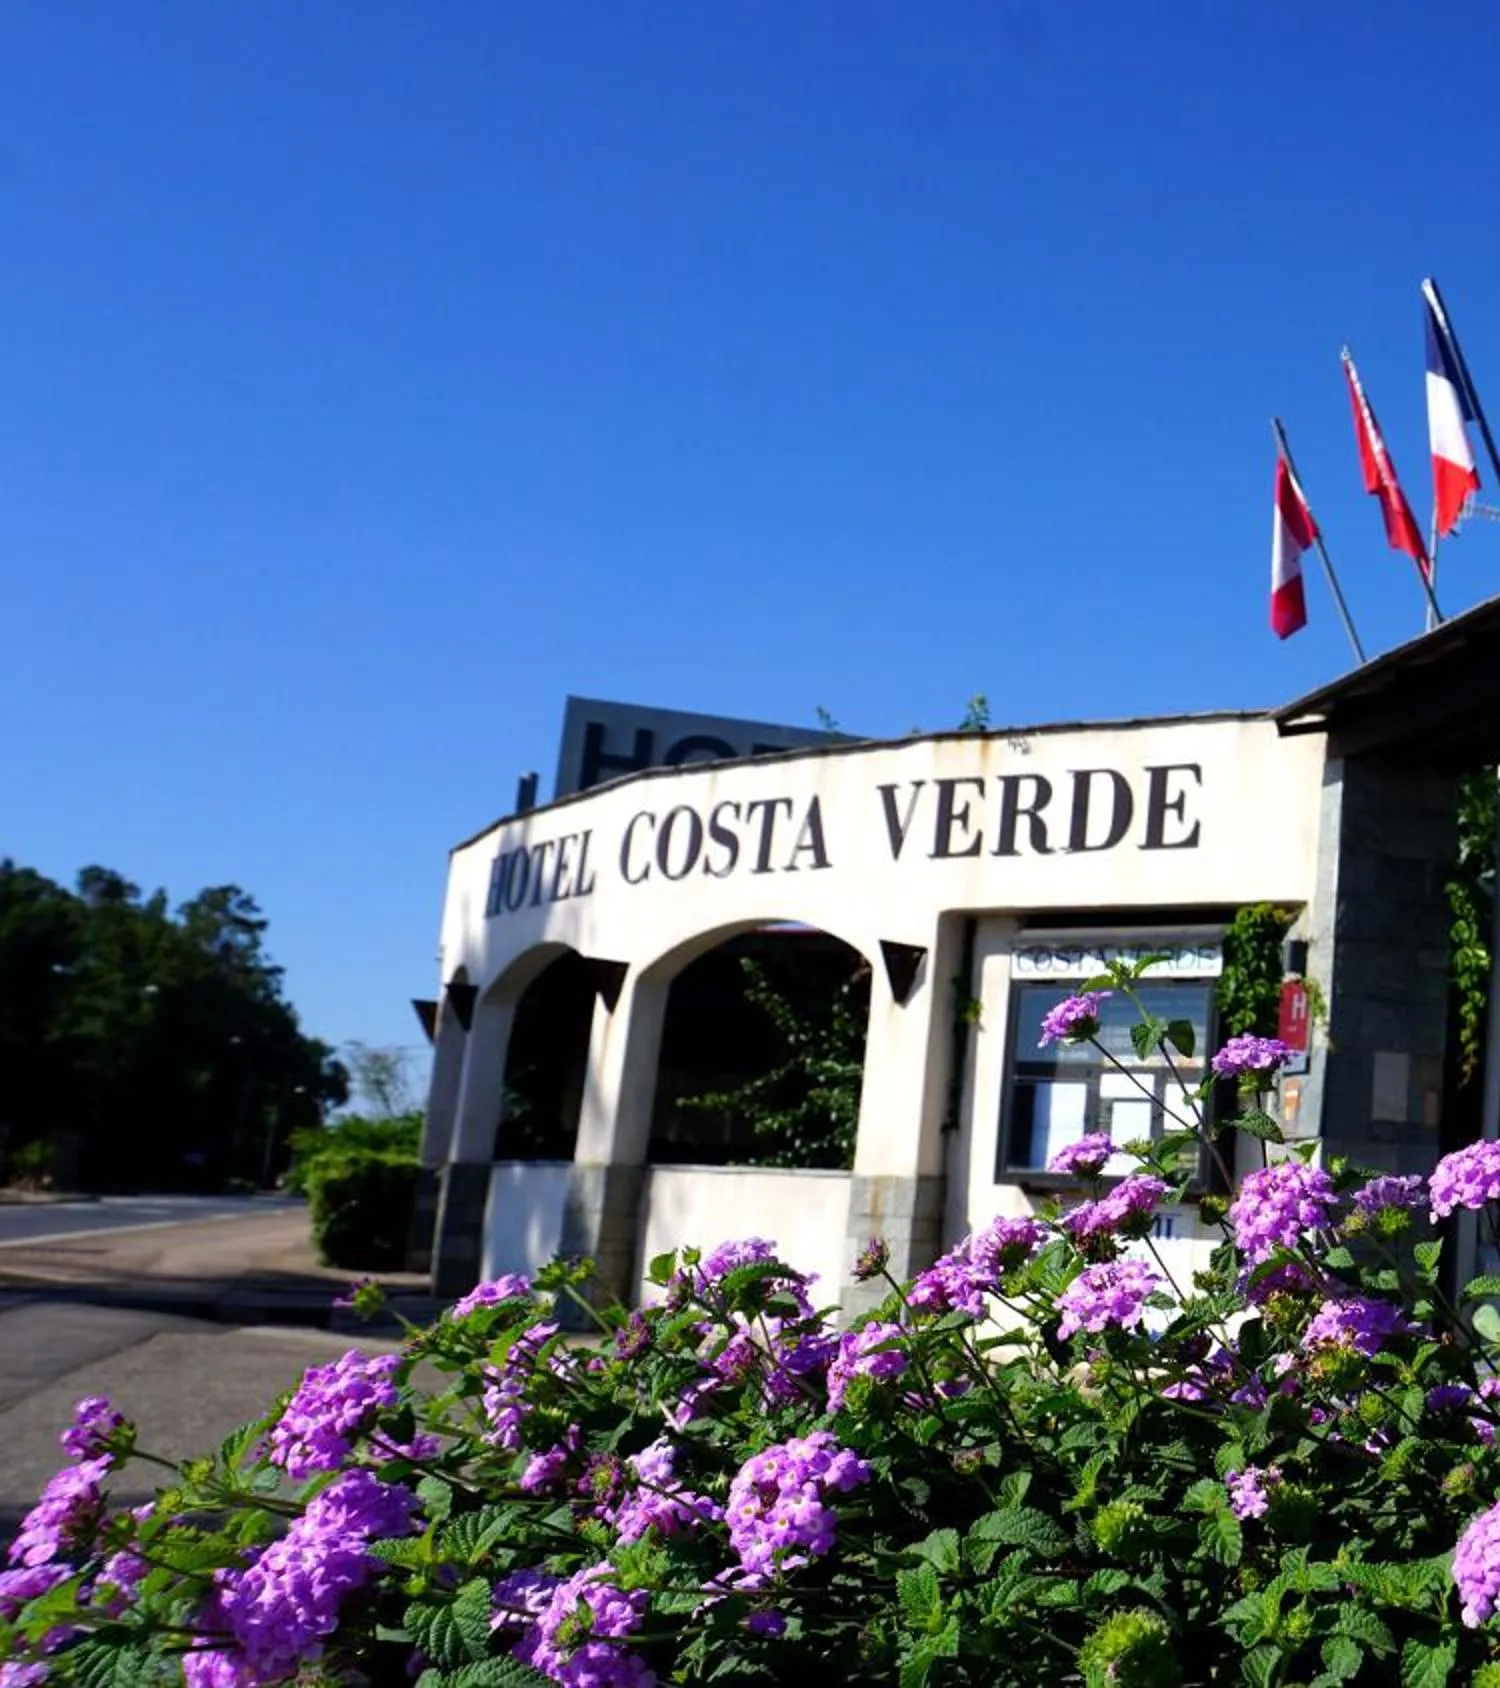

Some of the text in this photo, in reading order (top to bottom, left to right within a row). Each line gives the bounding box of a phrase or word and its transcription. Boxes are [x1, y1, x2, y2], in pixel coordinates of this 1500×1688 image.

[485, 763, 1203, 919] HOTEL COSTA VERDE
